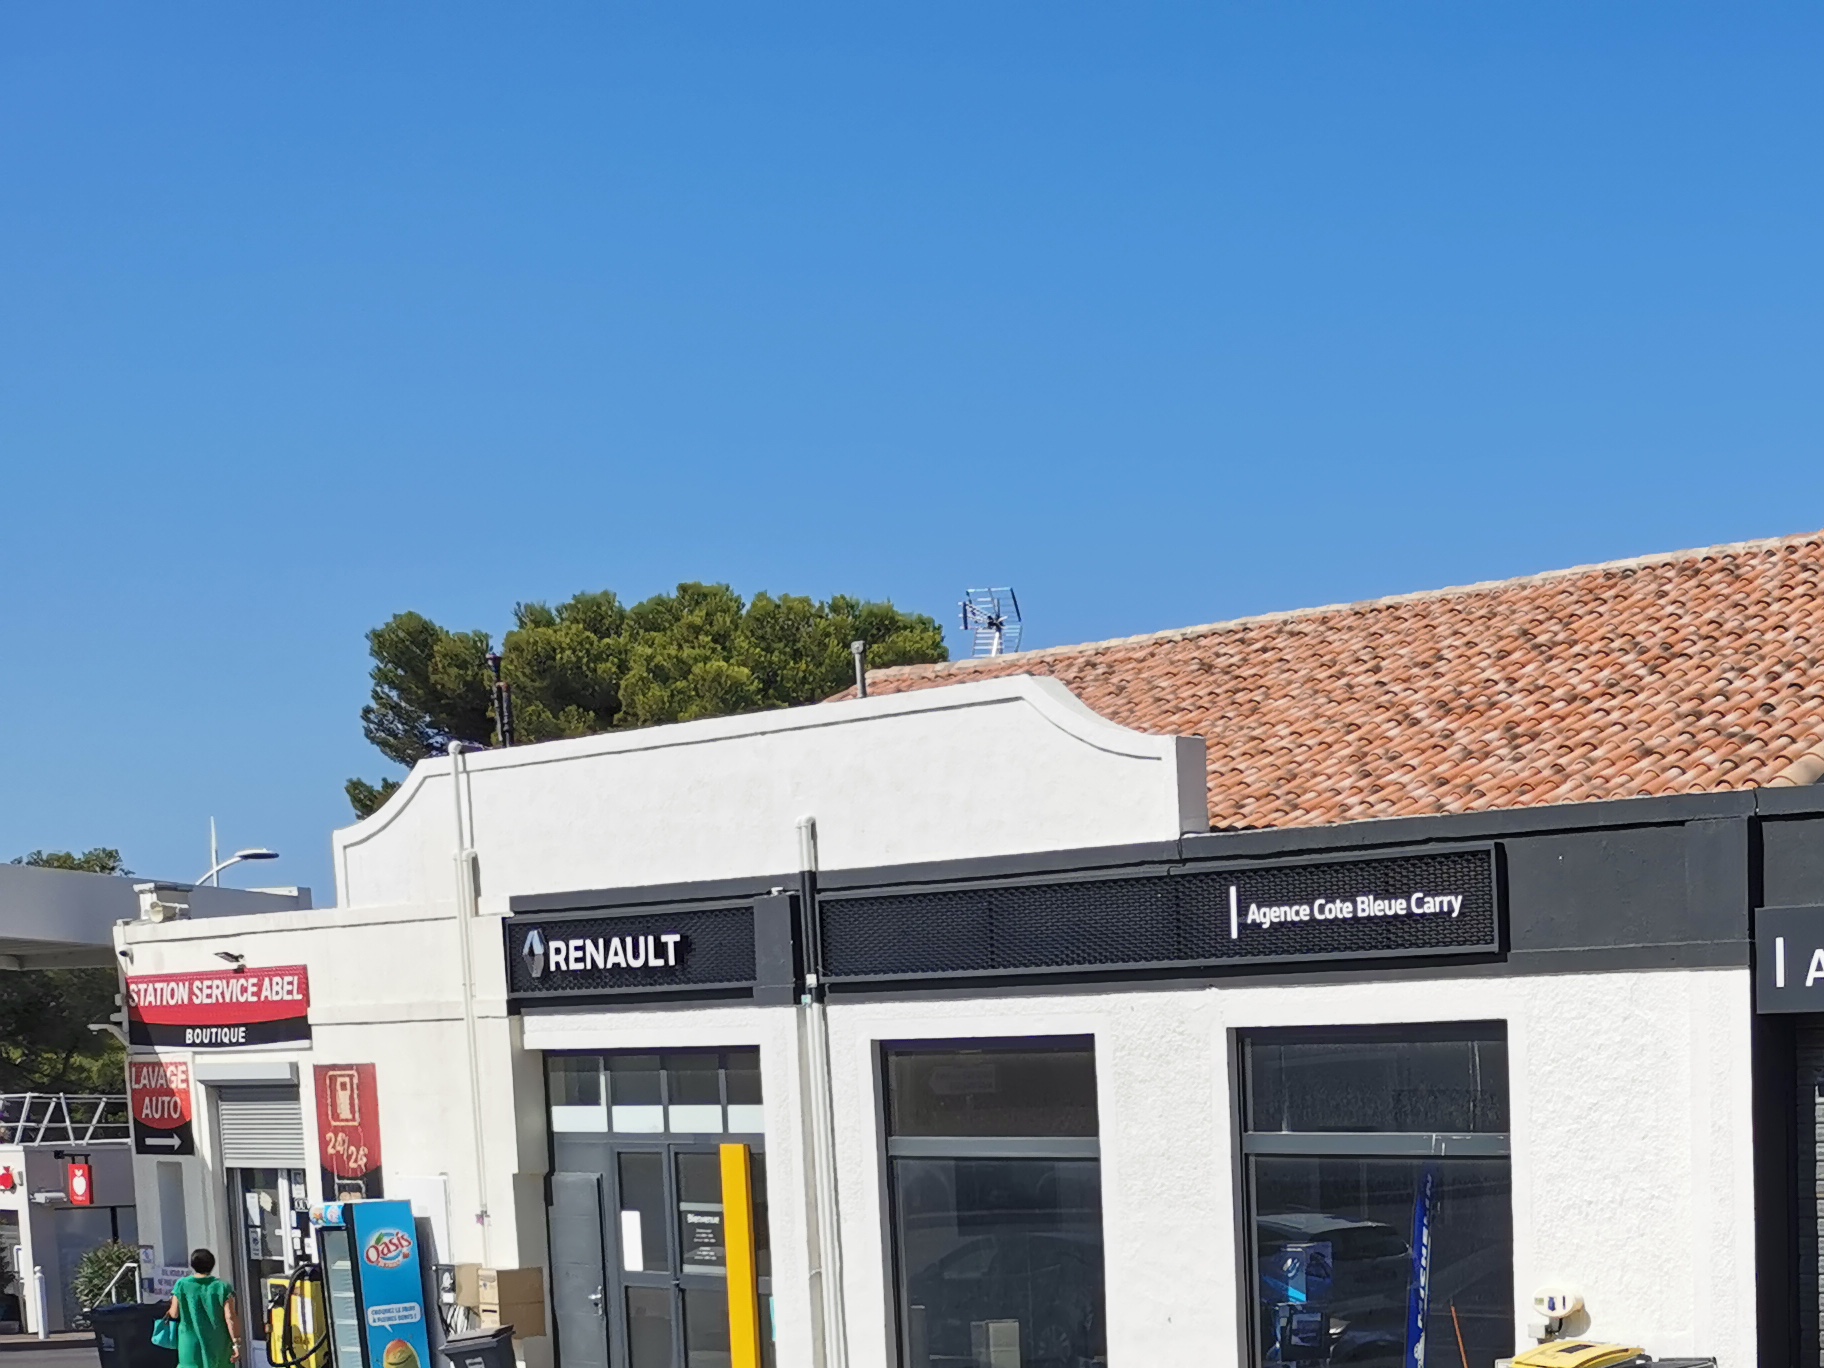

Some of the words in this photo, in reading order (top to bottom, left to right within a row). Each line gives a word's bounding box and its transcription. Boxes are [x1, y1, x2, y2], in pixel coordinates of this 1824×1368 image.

[1246, 903, 1310, 929] Agence
[1313, 899, 1353, 920] Cote
[1356, 895, 1407, 917] Bleue
[1411, 892, 1463, 917] Carry
[548, 934, 681, 972] RENAULT
[129, 982, 188, 1007] STATION
[191, 978, 258, 1005] SERVICE
[260, 975, 303, 1001] ABEL
[185, 1027, 247, 1044] BOUTIQUE
[131, 1065, 188, 1090] LAVAGE
[142, 1096, 181, 1119] AUTO
[365, 1231, 413, 1264] Oasis
